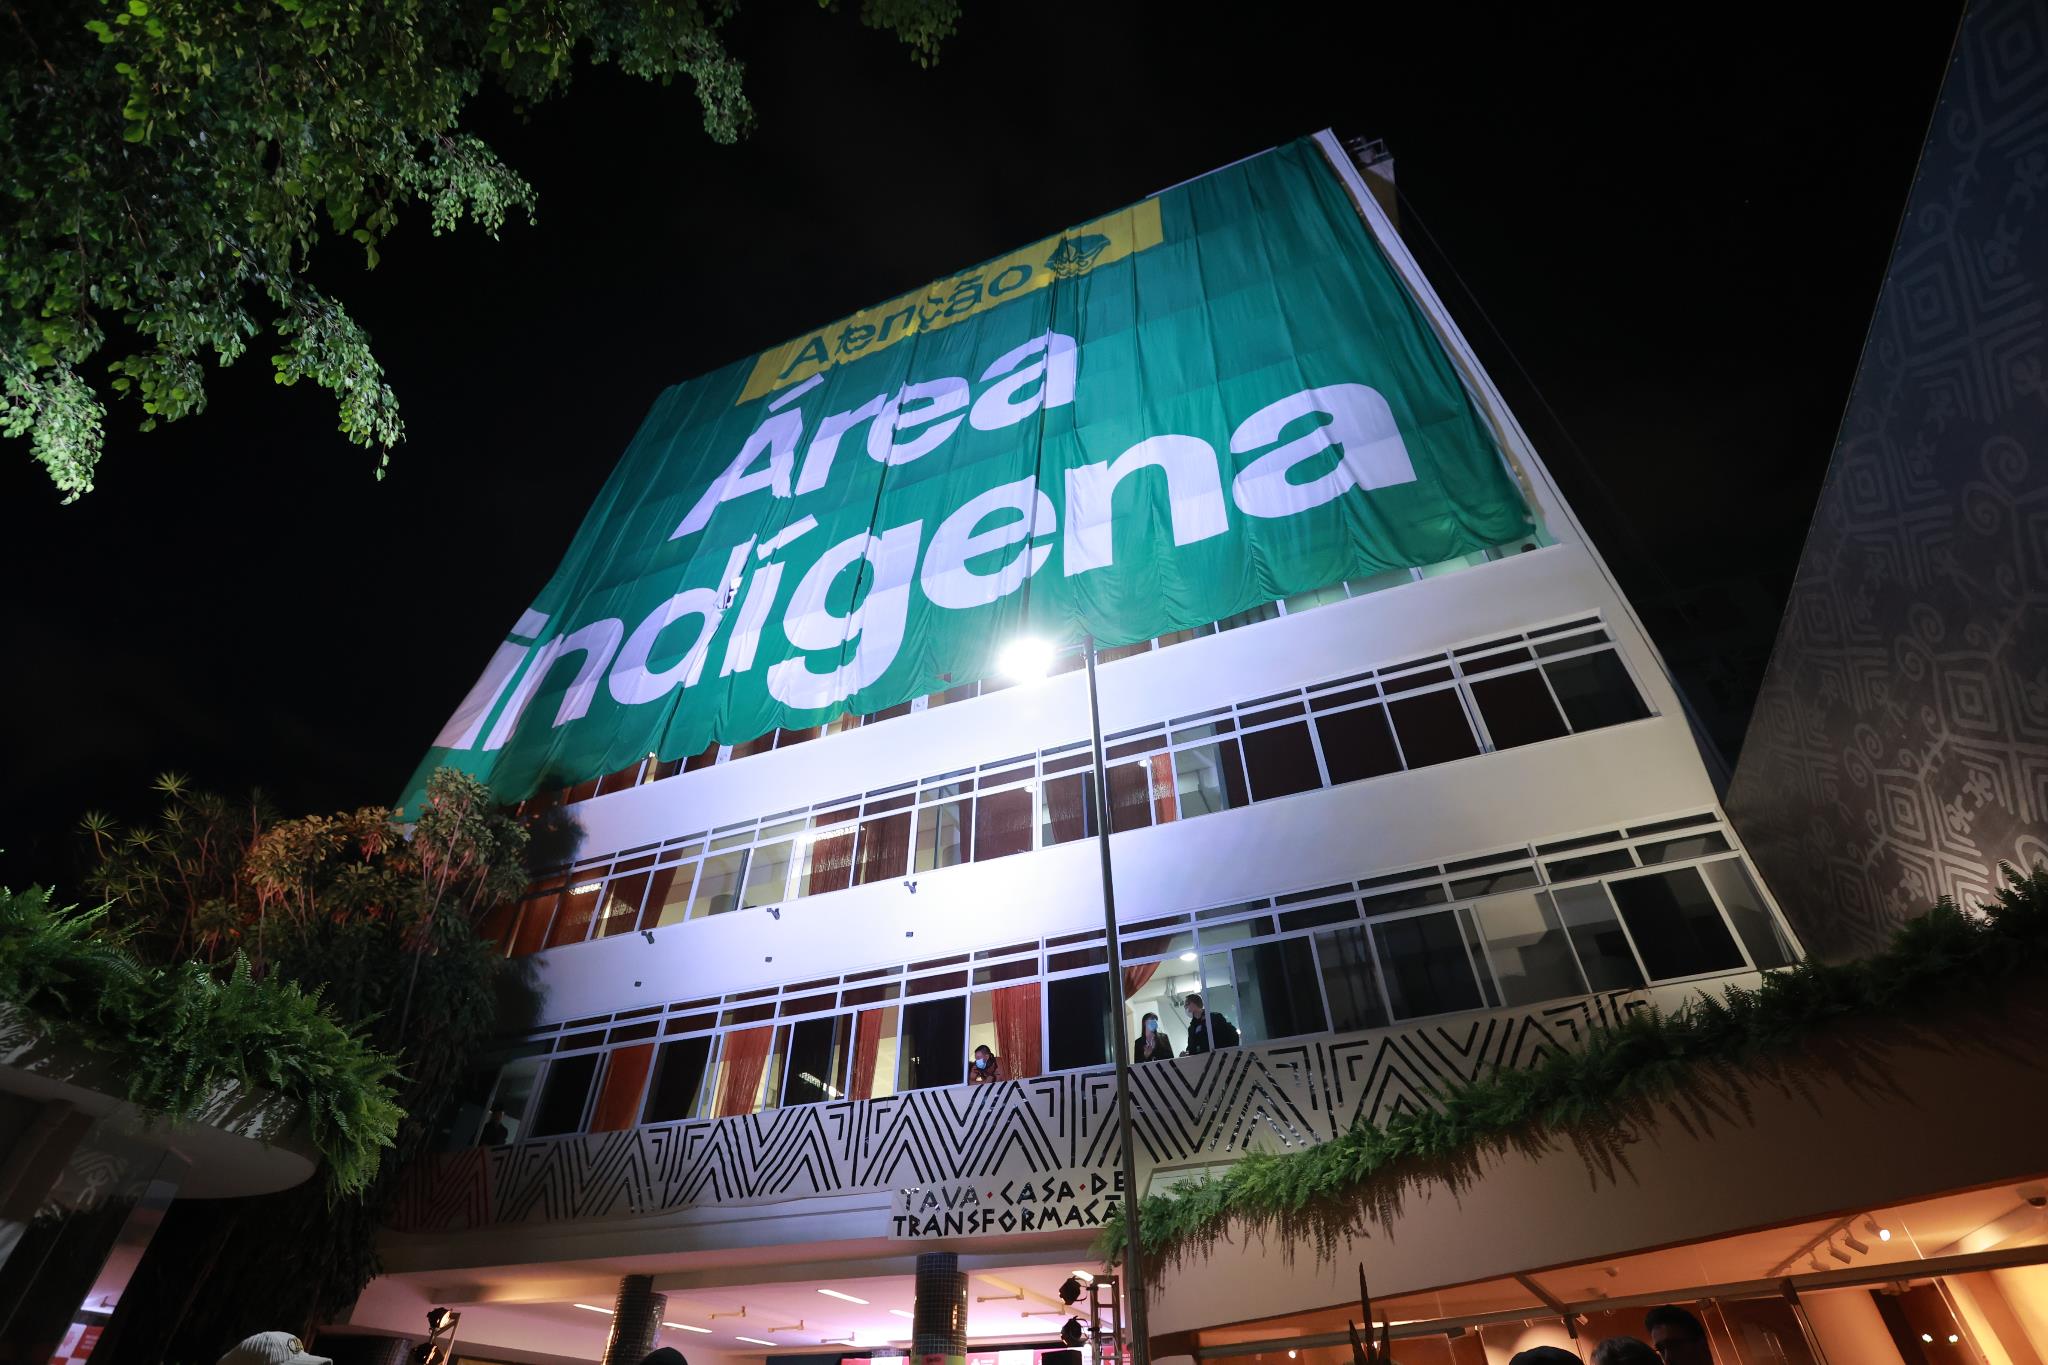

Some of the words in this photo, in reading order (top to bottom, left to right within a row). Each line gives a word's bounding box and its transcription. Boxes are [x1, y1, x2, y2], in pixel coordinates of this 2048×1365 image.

[778, 265, 1033, 379] Aenção
[672, 328, 1077, 540] Área
[893, 1194, 1121, 1236] TRANSFORMAÇÃ
[901, 1184, 980, 1213] TAVA
[1000, 1176, 1075, 1206] CASA
[1091, 1171, 1124, 1195] DE
